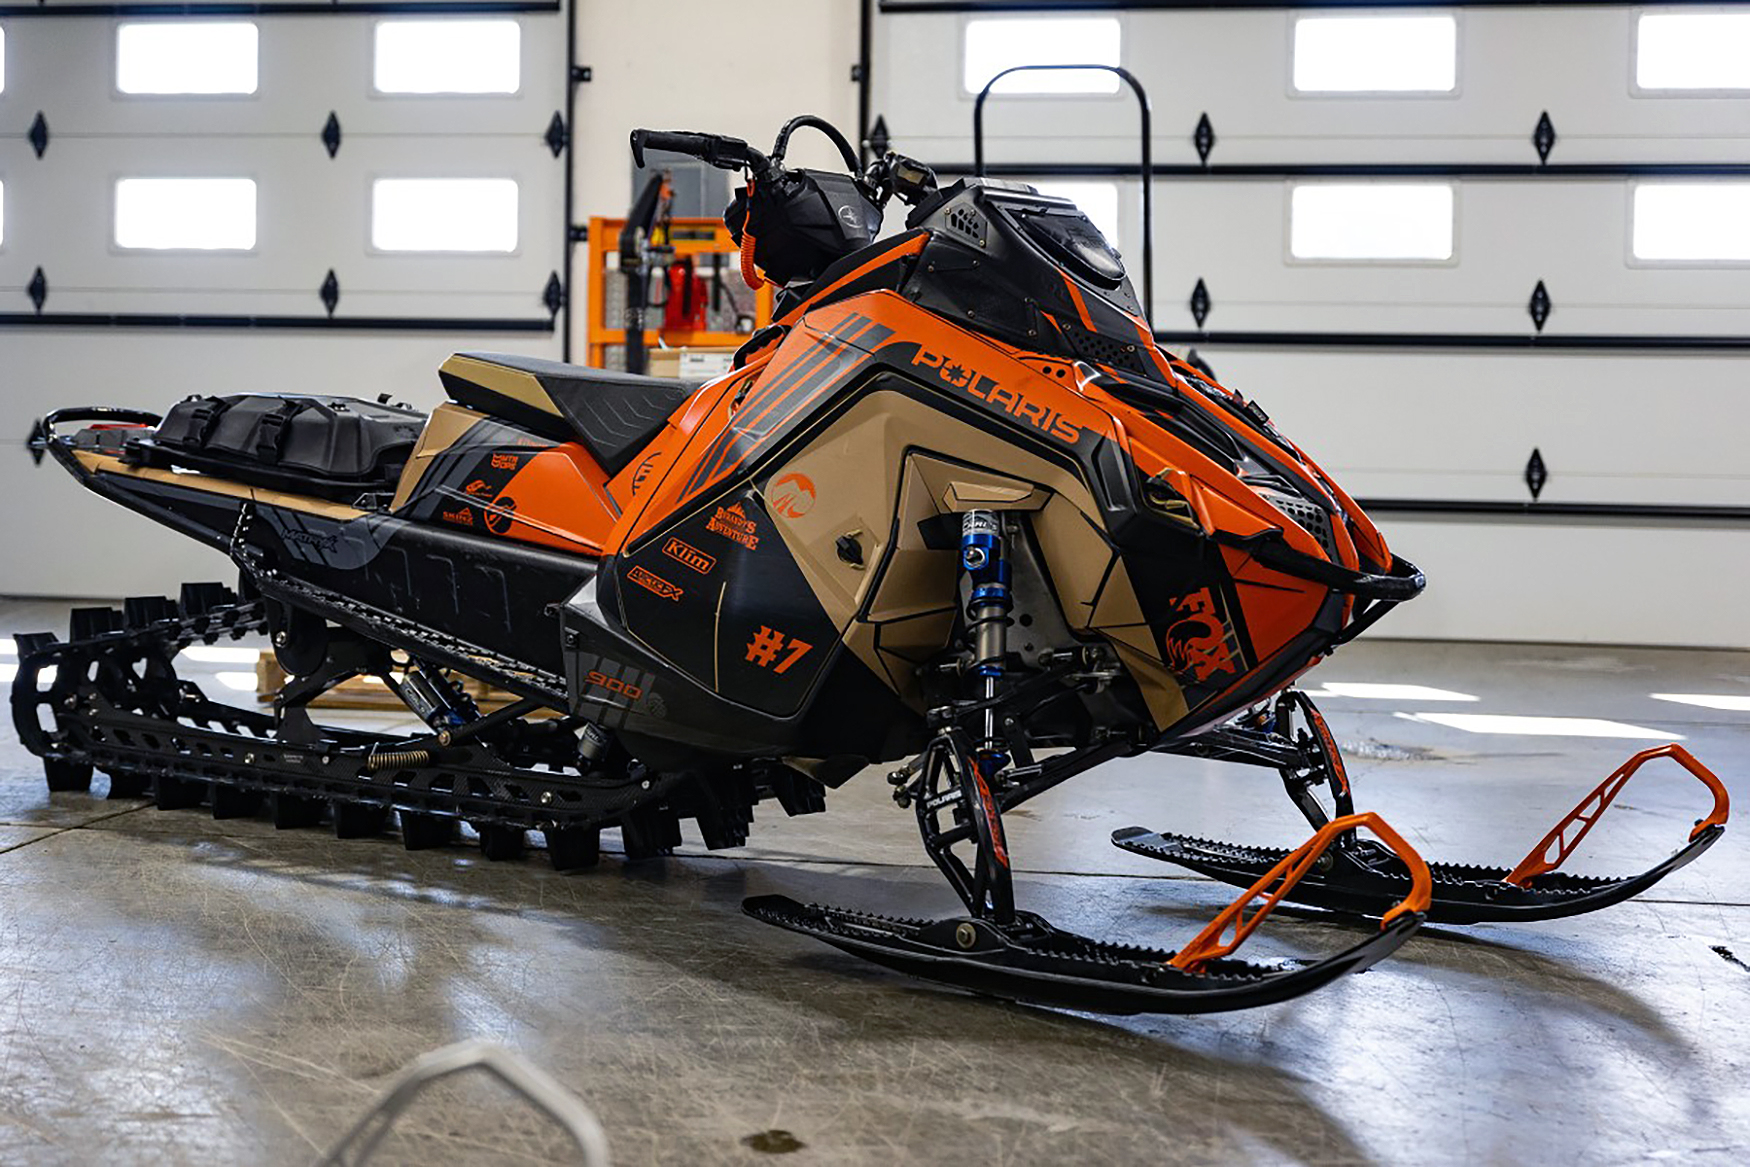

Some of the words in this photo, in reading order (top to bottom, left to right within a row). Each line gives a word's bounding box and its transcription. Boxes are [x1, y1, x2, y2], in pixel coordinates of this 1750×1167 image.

[911, 348, 1080, 444] POLARIS
[745, 625, 813, 674] #7
[585, 671, 644, 699] 900
